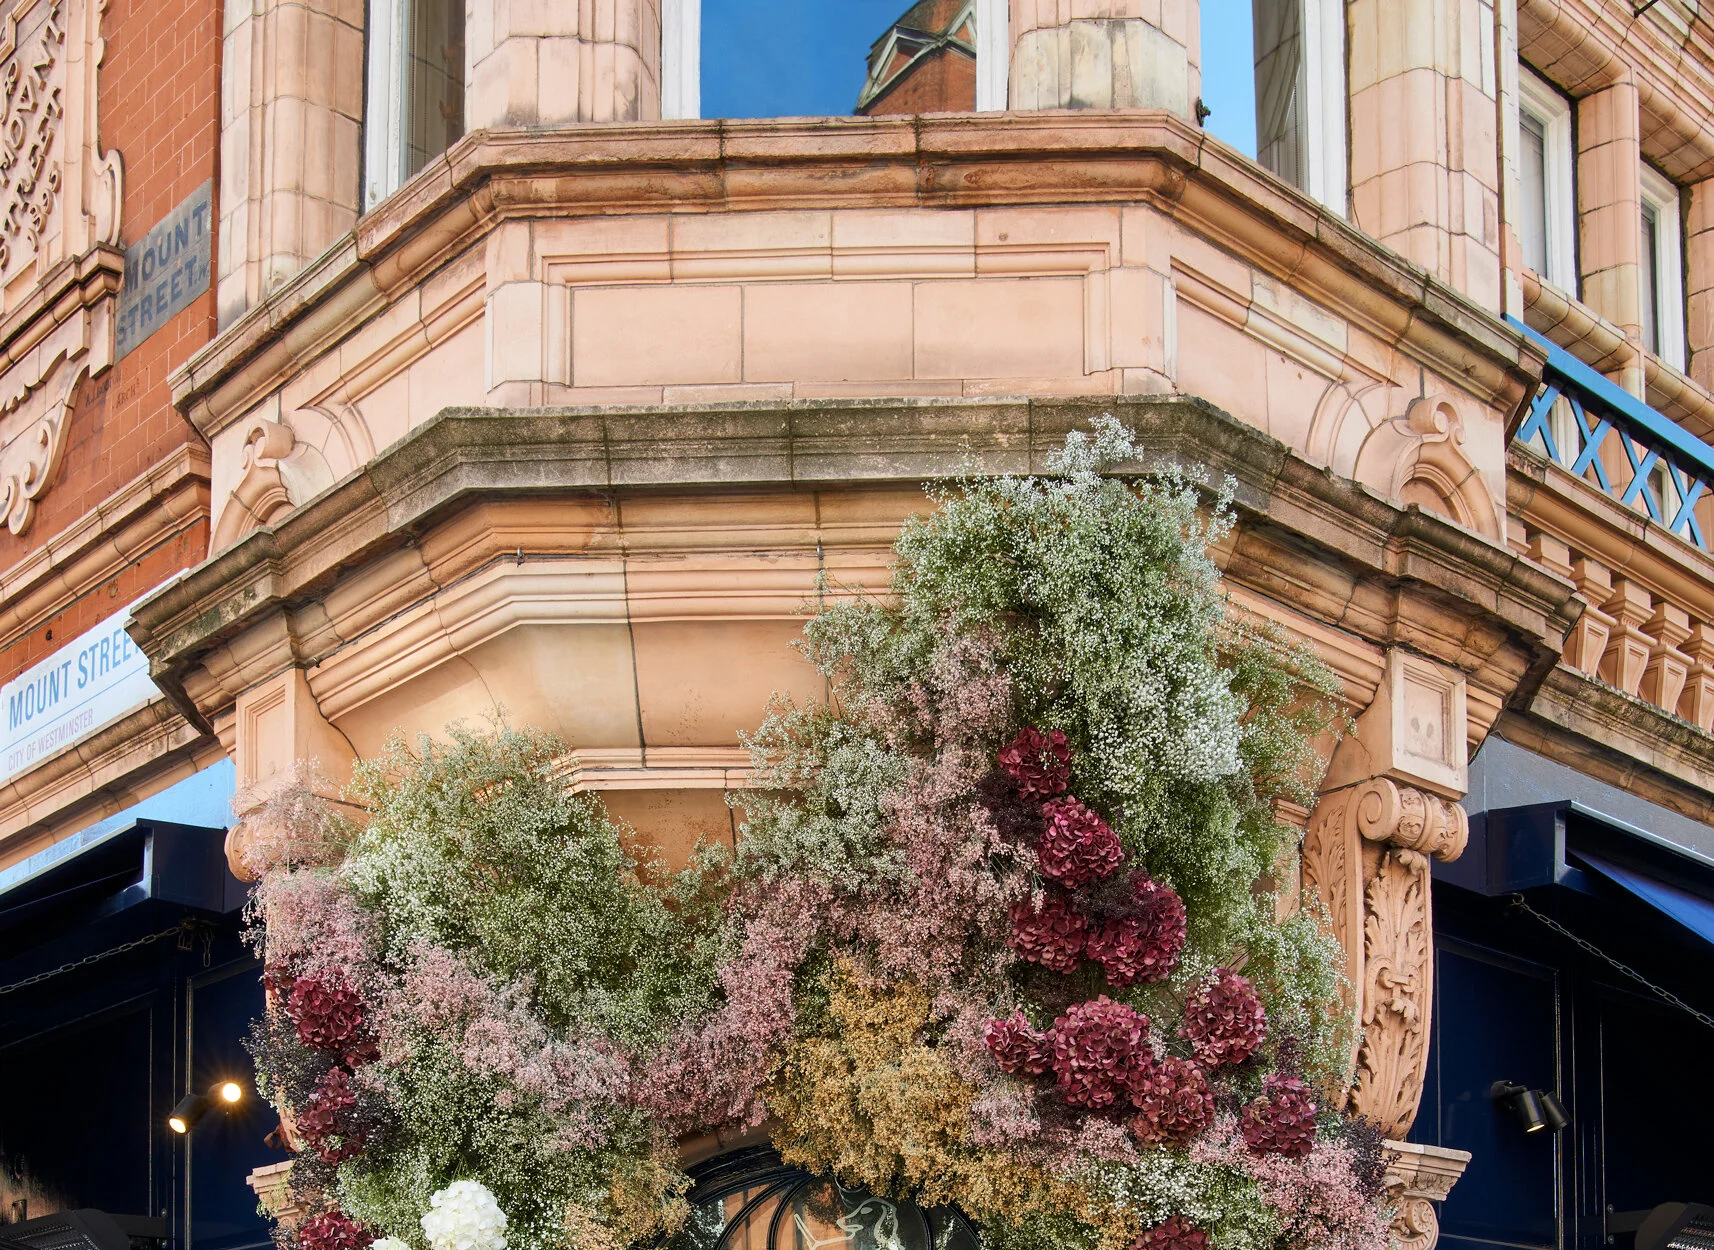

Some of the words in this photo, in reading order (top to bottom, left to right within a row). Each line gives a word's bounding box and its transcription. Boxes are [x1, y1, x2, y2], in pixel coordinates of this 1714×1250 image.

[123, 200, 208, 298] MOUNT
[9, 659, 72, 732] MOUNT
[8, 749, 24, 772] CITY
[26, 740, 37, 761] OF
[37, 708, 94, 754] WESTMINSTER
